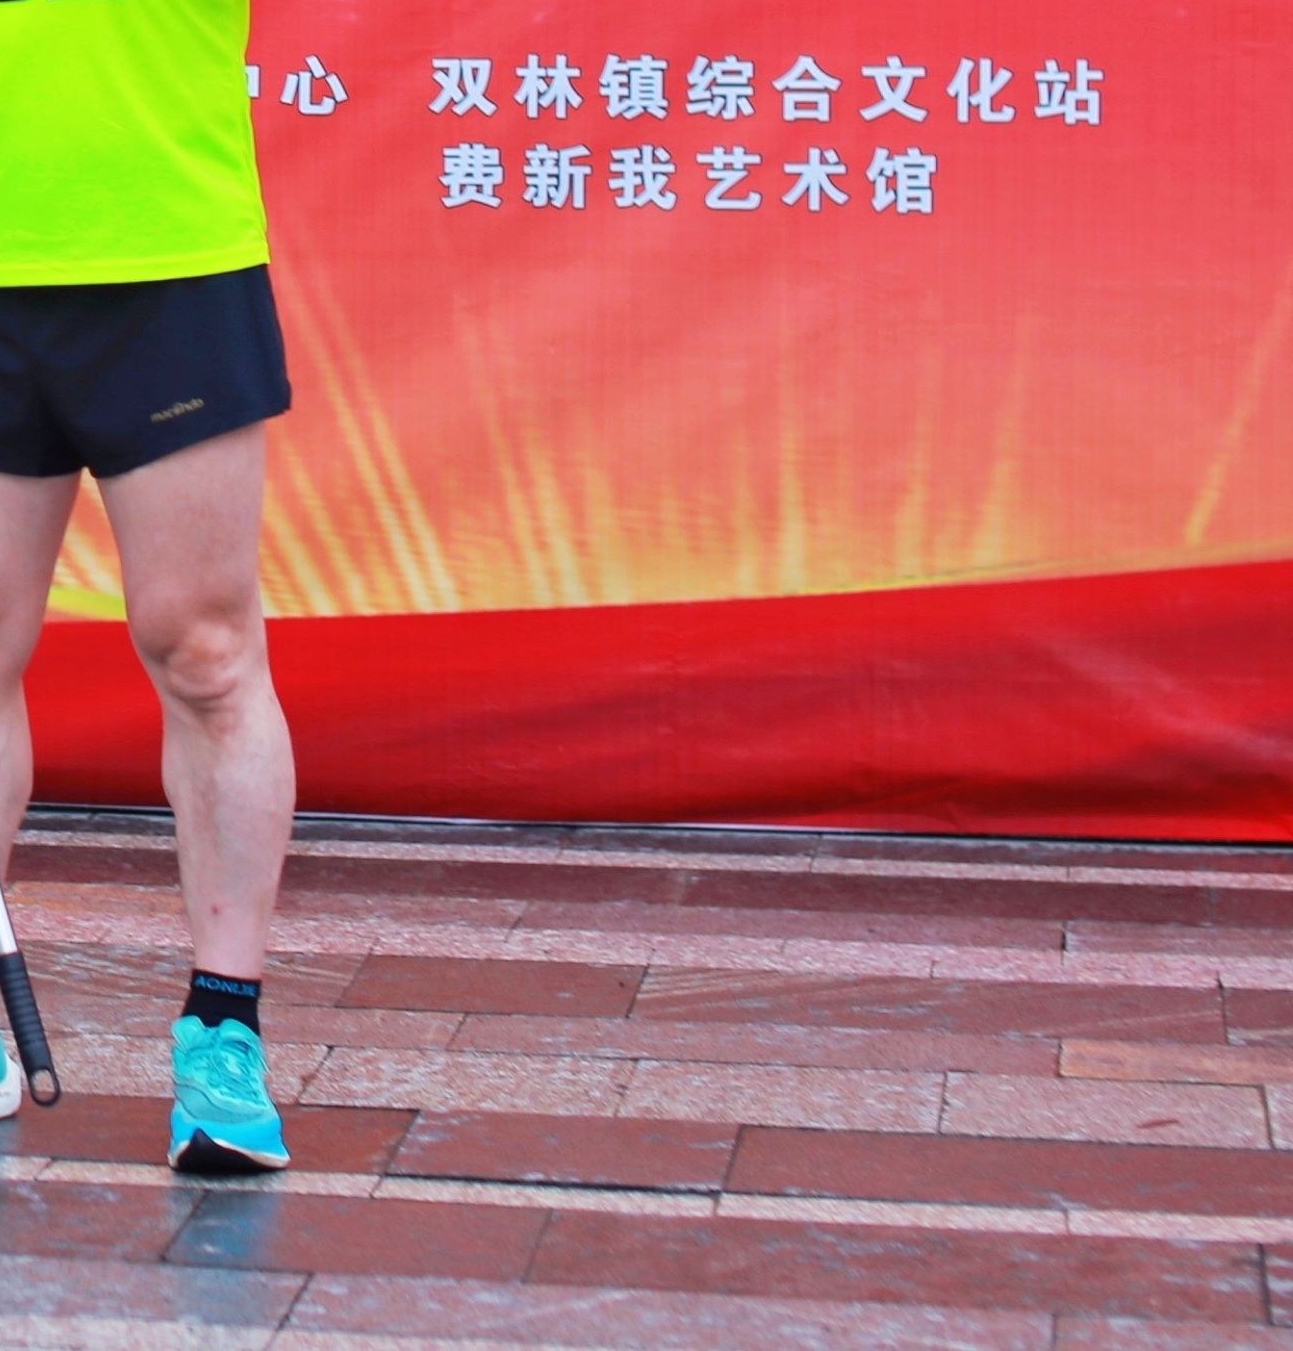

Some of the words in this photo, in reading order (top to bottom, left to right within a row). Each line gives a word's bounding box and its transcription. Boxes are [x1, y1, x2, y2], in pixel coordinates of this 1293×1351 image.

[245, 54, 350, 116] 心
[429, 54, 1105, 126] 双林镇综合文化站
[438, 144, 939, 215] 费新我艺术馆
